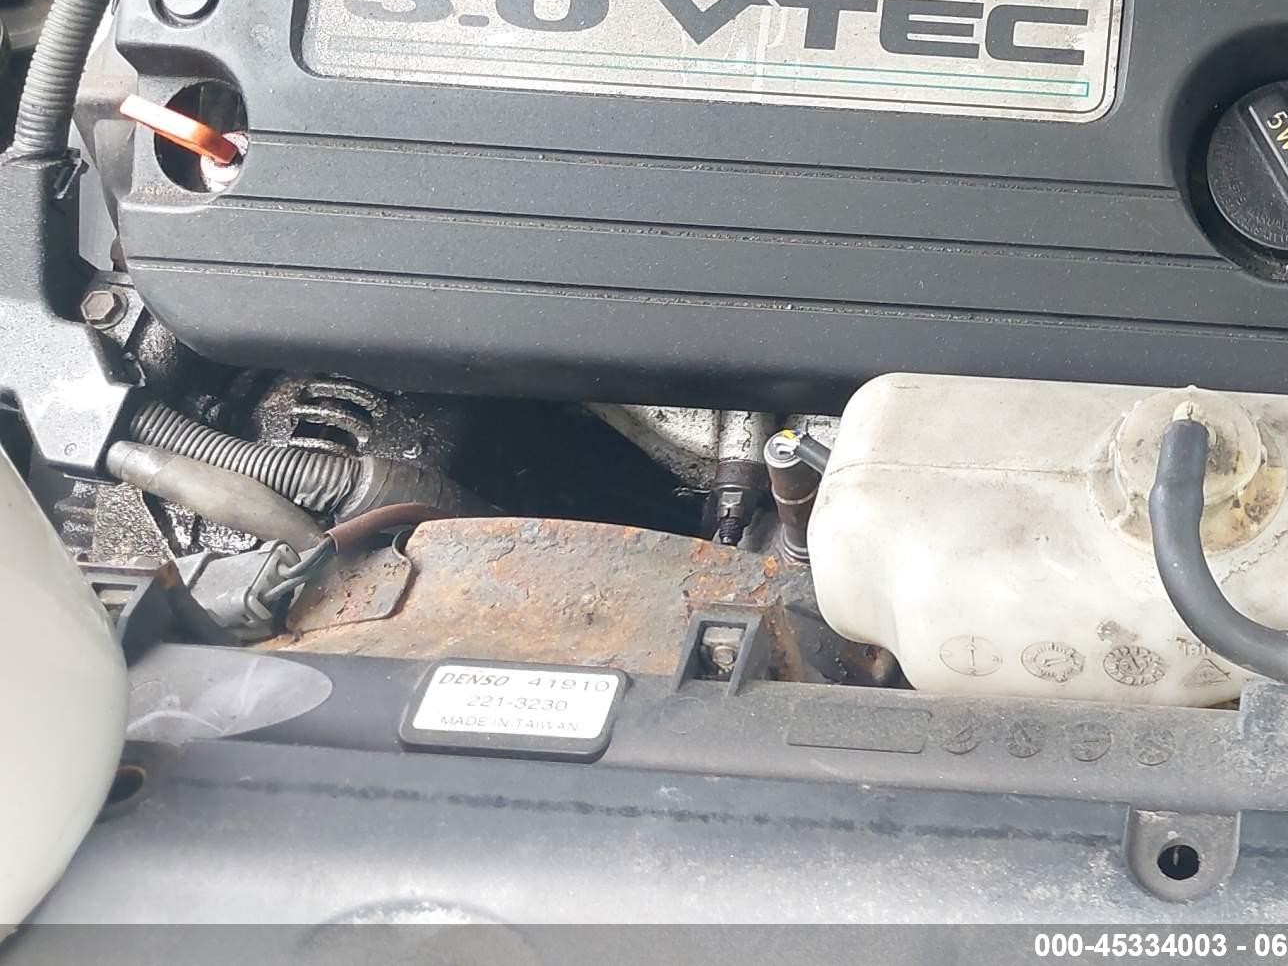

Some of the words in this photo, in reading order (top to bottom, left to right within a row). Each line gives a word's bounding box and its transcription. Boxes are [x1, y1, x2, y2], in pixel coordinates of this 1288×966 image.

[438, 672, 511, 687] DENSO
[527, 677, 611, 693] 41910
[466, 694, 568, 713] 221-3230
[440, 715, 486, 729] MADE
[492, 719, 509, 729] IN
[515, 719, 579, 733] TAIWAN
